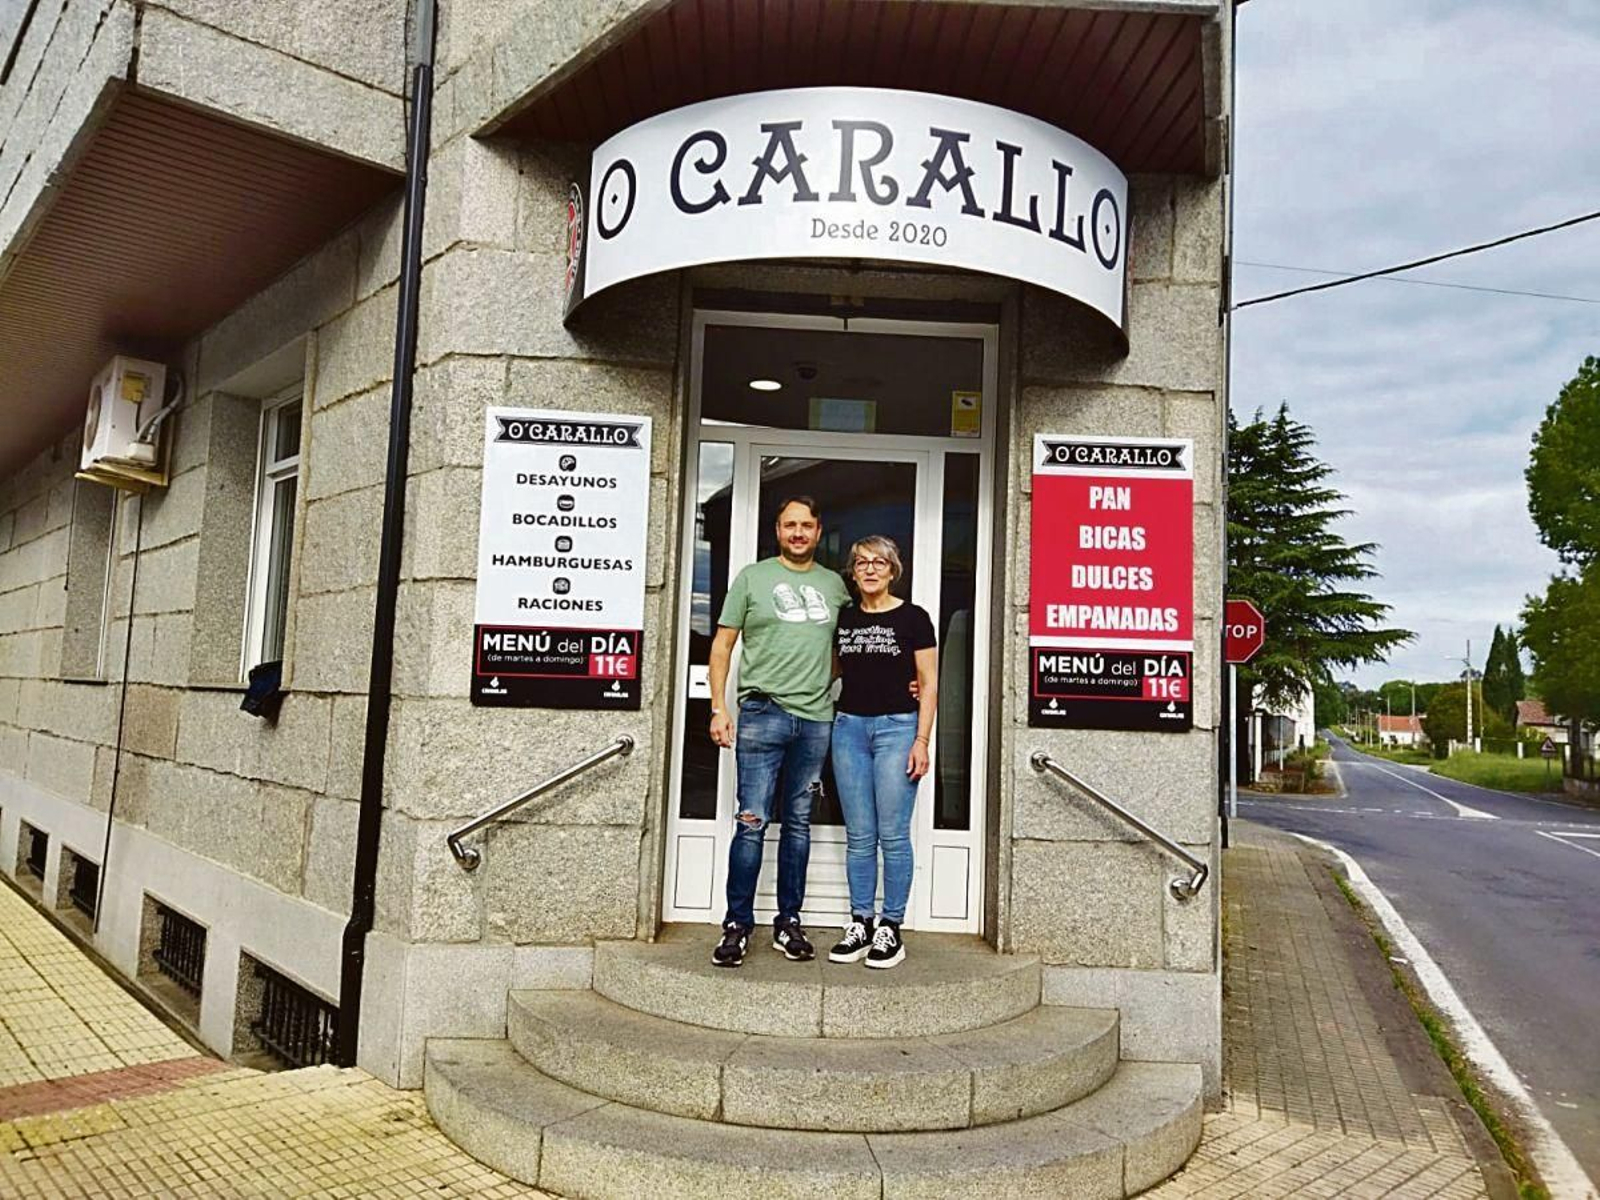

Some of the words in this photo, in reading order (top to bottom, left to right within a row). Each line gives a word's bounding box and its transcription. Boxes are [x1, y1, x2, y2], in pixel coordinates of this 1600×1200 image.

[597, 159, 636, 240] O
[670, 119, 1120, 270] CARALLO
[810, 218, 878, 240] Desde
[888, 221, 948, 248] 2020
[516, 473, 617, 489] DESAYUNOS
[1089, 485, 1131, 510] PAN
[512, 513, 617, 529] BOCADILLOS
[1079, 525, 1146, 550] BICAS
[492, 554, 633, 571] HAMBURGUESAS
[1071, 565, 1153, 591] DULCES
[517, 597, 603, 611] RACIONES
[1046, 604, 1178, 632] EMPANADAS
[1225, 624, 1258, 639] TOP
[483, 631, 550, 652] MENÚ
[557, 639, 584, 653] del
[591, 633, 631, 654] DÍA
[487, 653, 502, 662] (de
[543, 655, 584, 664] domingo)
[594, 656, 629, 675] 11€
[1039, 653, 1104, 674] MENÚ
[1111, 661, 1136, 675] del
[1144, 656, 1183, 677] DÍA
[1044, 675, 1058, 684] (de
[1060, 676, 1088, 684] martes
[1098, 677, 1138, 686] domingo)
[1148, 677, 1182, 698] 11€
